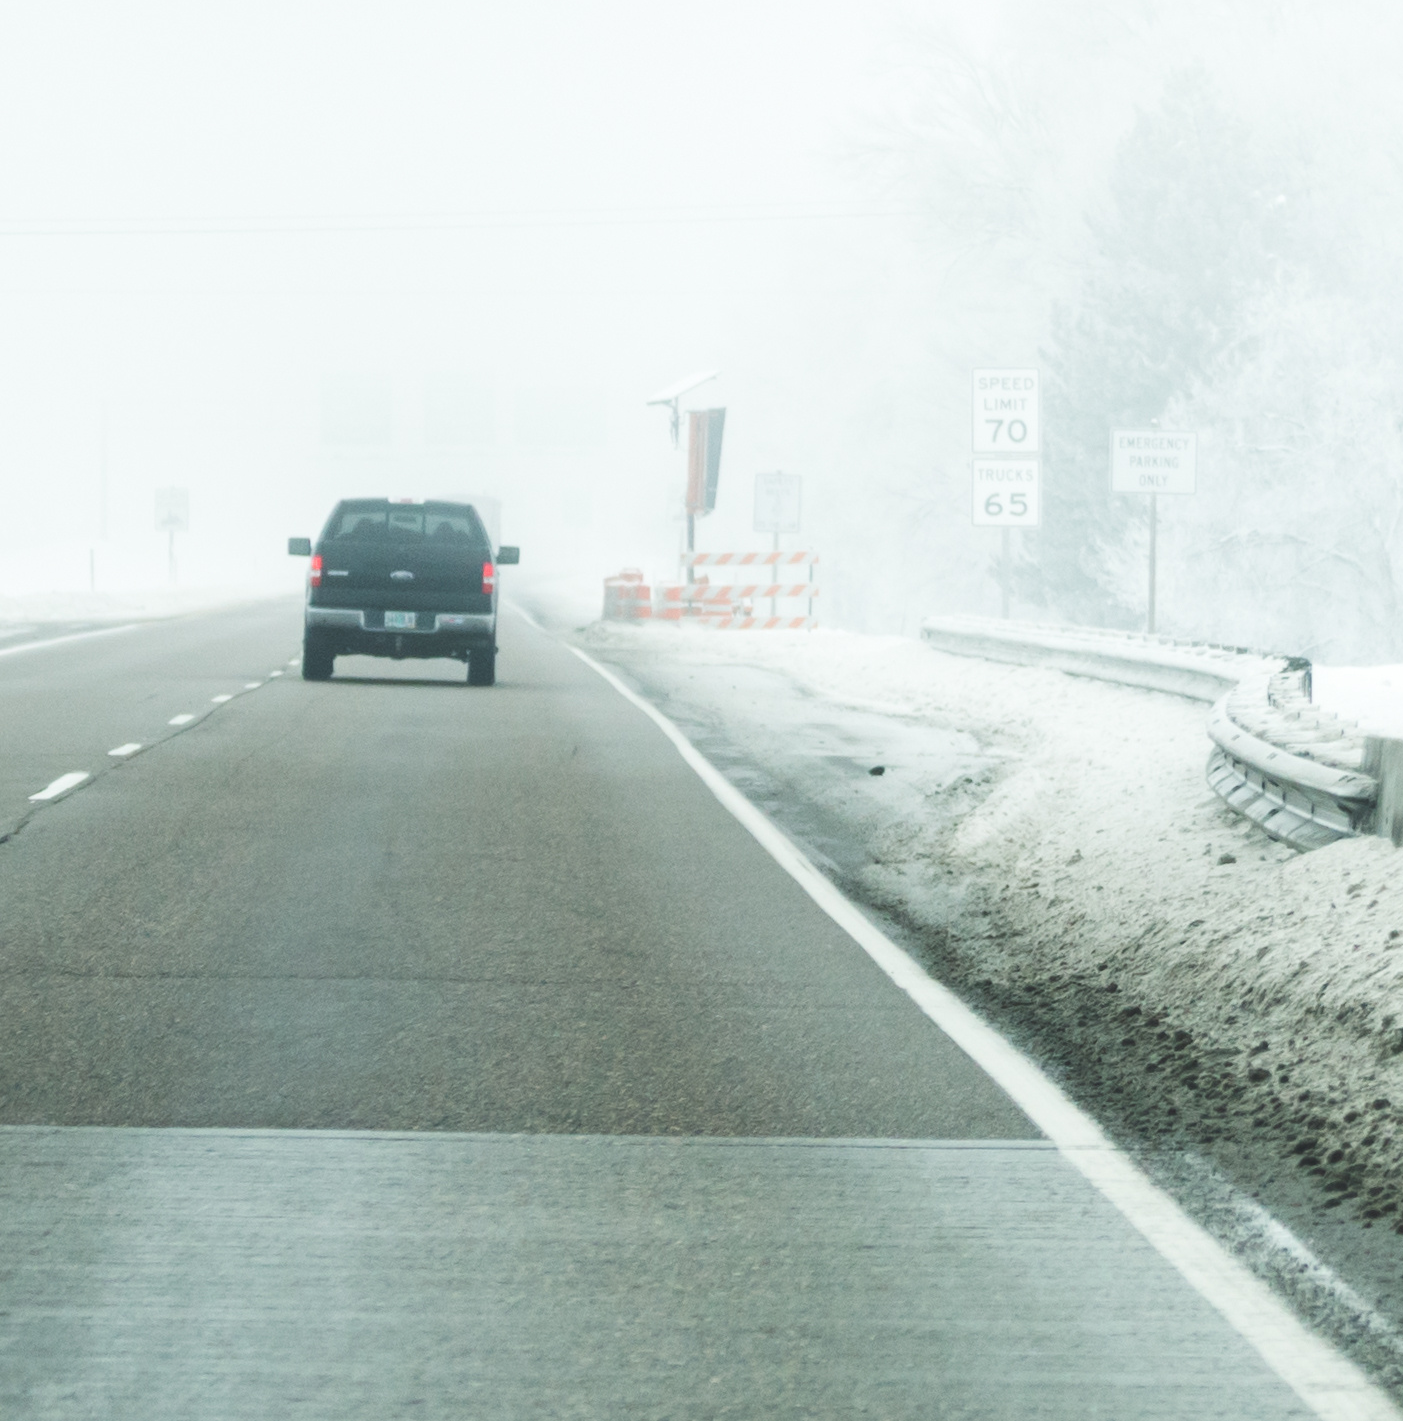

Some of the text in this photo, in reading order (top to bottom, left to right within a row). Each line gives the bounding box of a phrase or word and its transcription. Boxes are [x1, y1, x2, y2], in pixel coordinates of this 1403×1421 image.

[978, 377, 1034, 390] SPEED
[984, 398, 1027, 411] LIMIT
[985, 418, 1027, 444] 70
[1119, 436, 1189, 450] EMERGENCY
[1129, 455, 1179, 469] PARKING
[978, 468, 1034, 482] TRUCKS
[1139, 474, 1168, 487] ONLY
[984, 492, 1028, 517] 65
